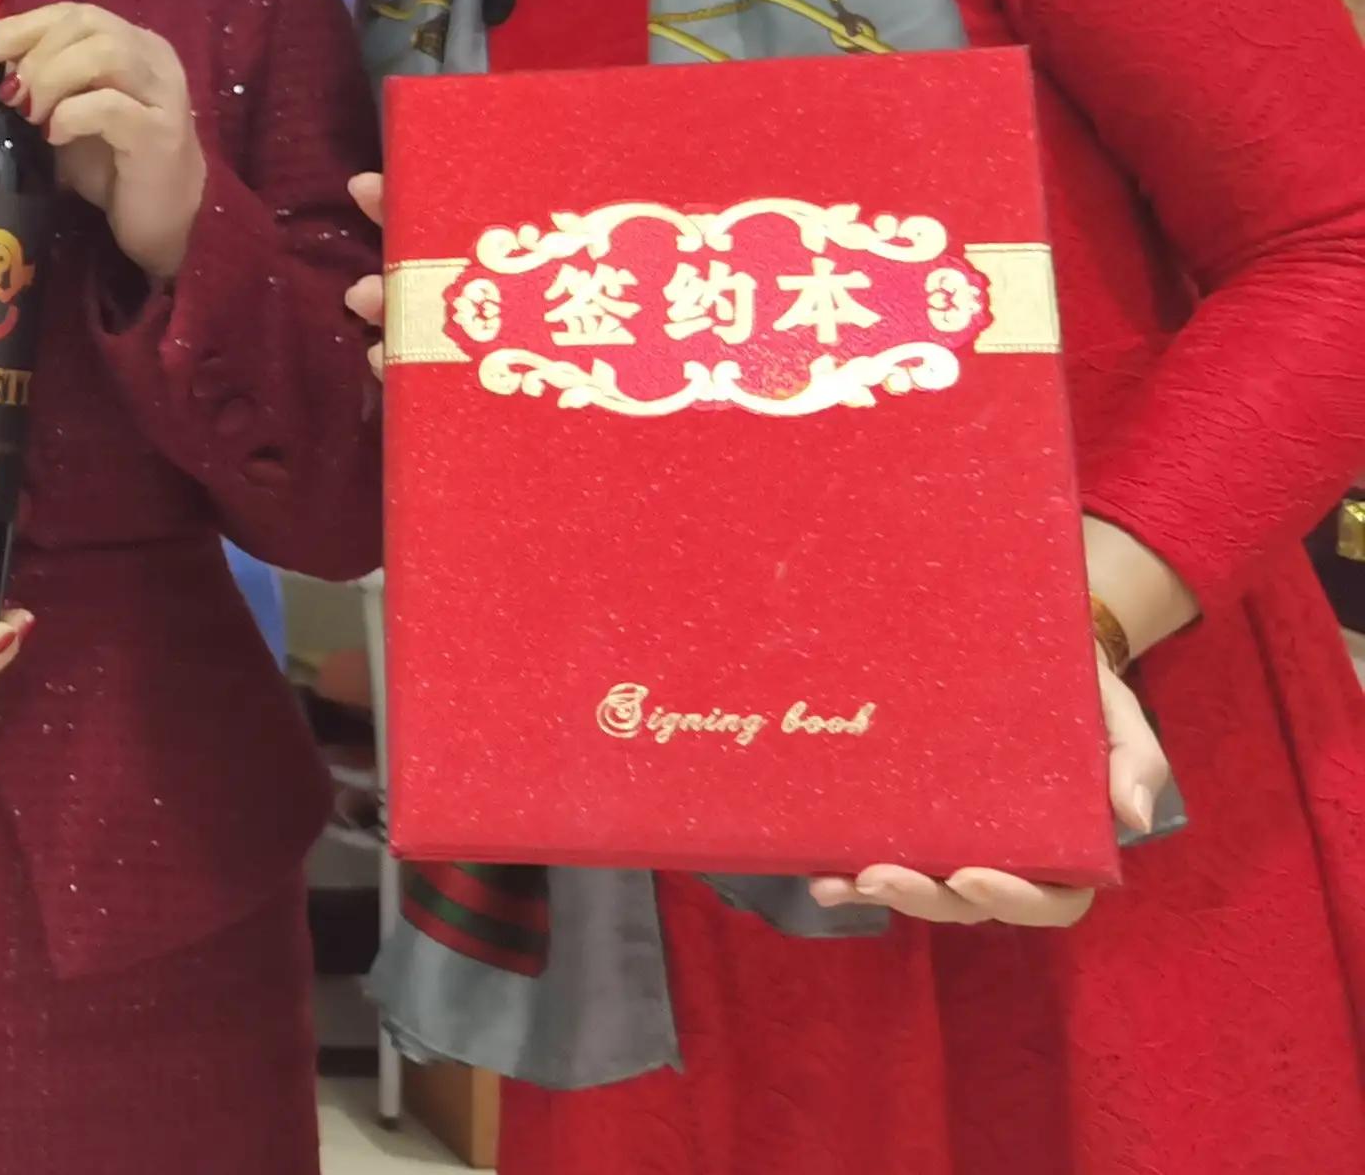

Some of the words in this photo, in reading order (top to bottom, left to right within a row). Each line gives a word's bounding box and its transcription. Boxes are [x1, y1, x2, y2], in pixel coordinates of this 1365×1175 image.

[544, 258, 882, 345] 签约本
[596, 682, 768, 746] Signing
[780, 700, 878, 735] book
